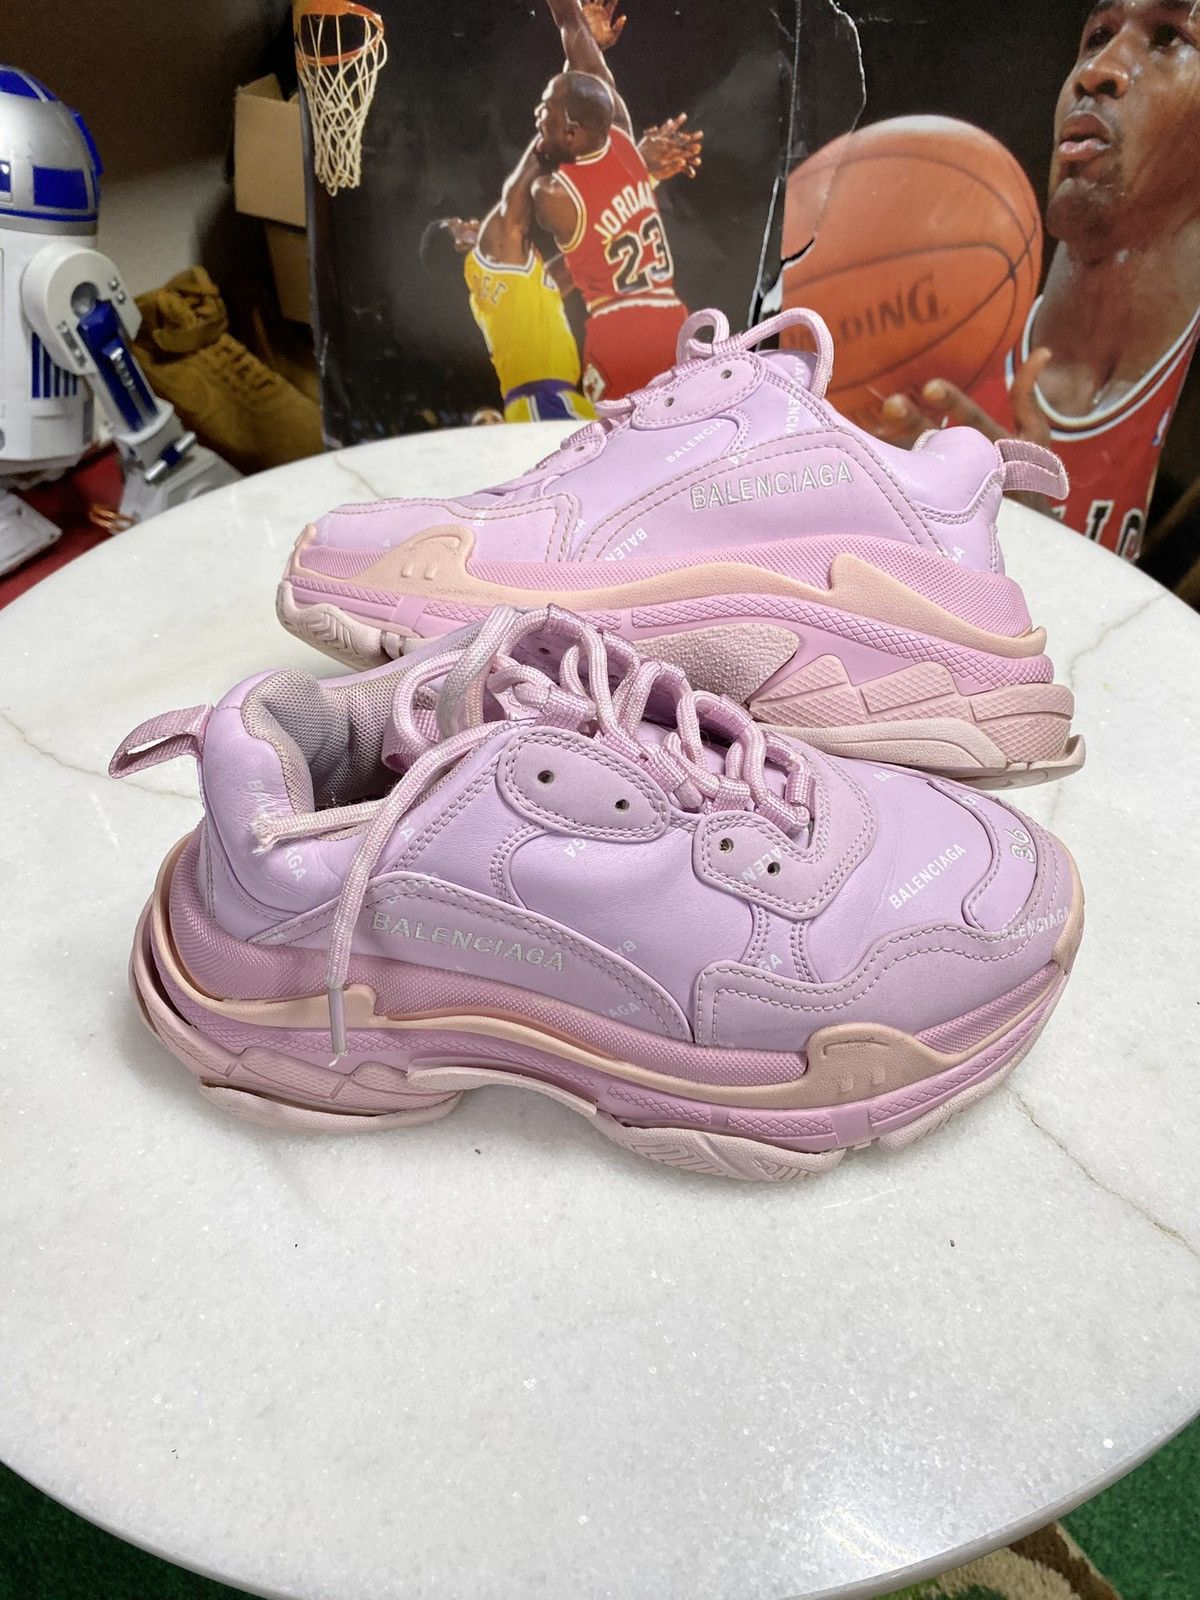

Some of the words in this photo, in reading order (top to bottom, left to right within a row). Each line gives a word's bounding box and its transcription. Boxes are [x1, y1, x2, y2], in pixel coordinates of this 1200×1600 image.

[604, 211, 674, 294] 23
[690, 461, 854, 511] BALENCIAGA
[888, 843, 968, 910] BALENCIAGA
[371, 911, 566, 972] BALENCIAGA
